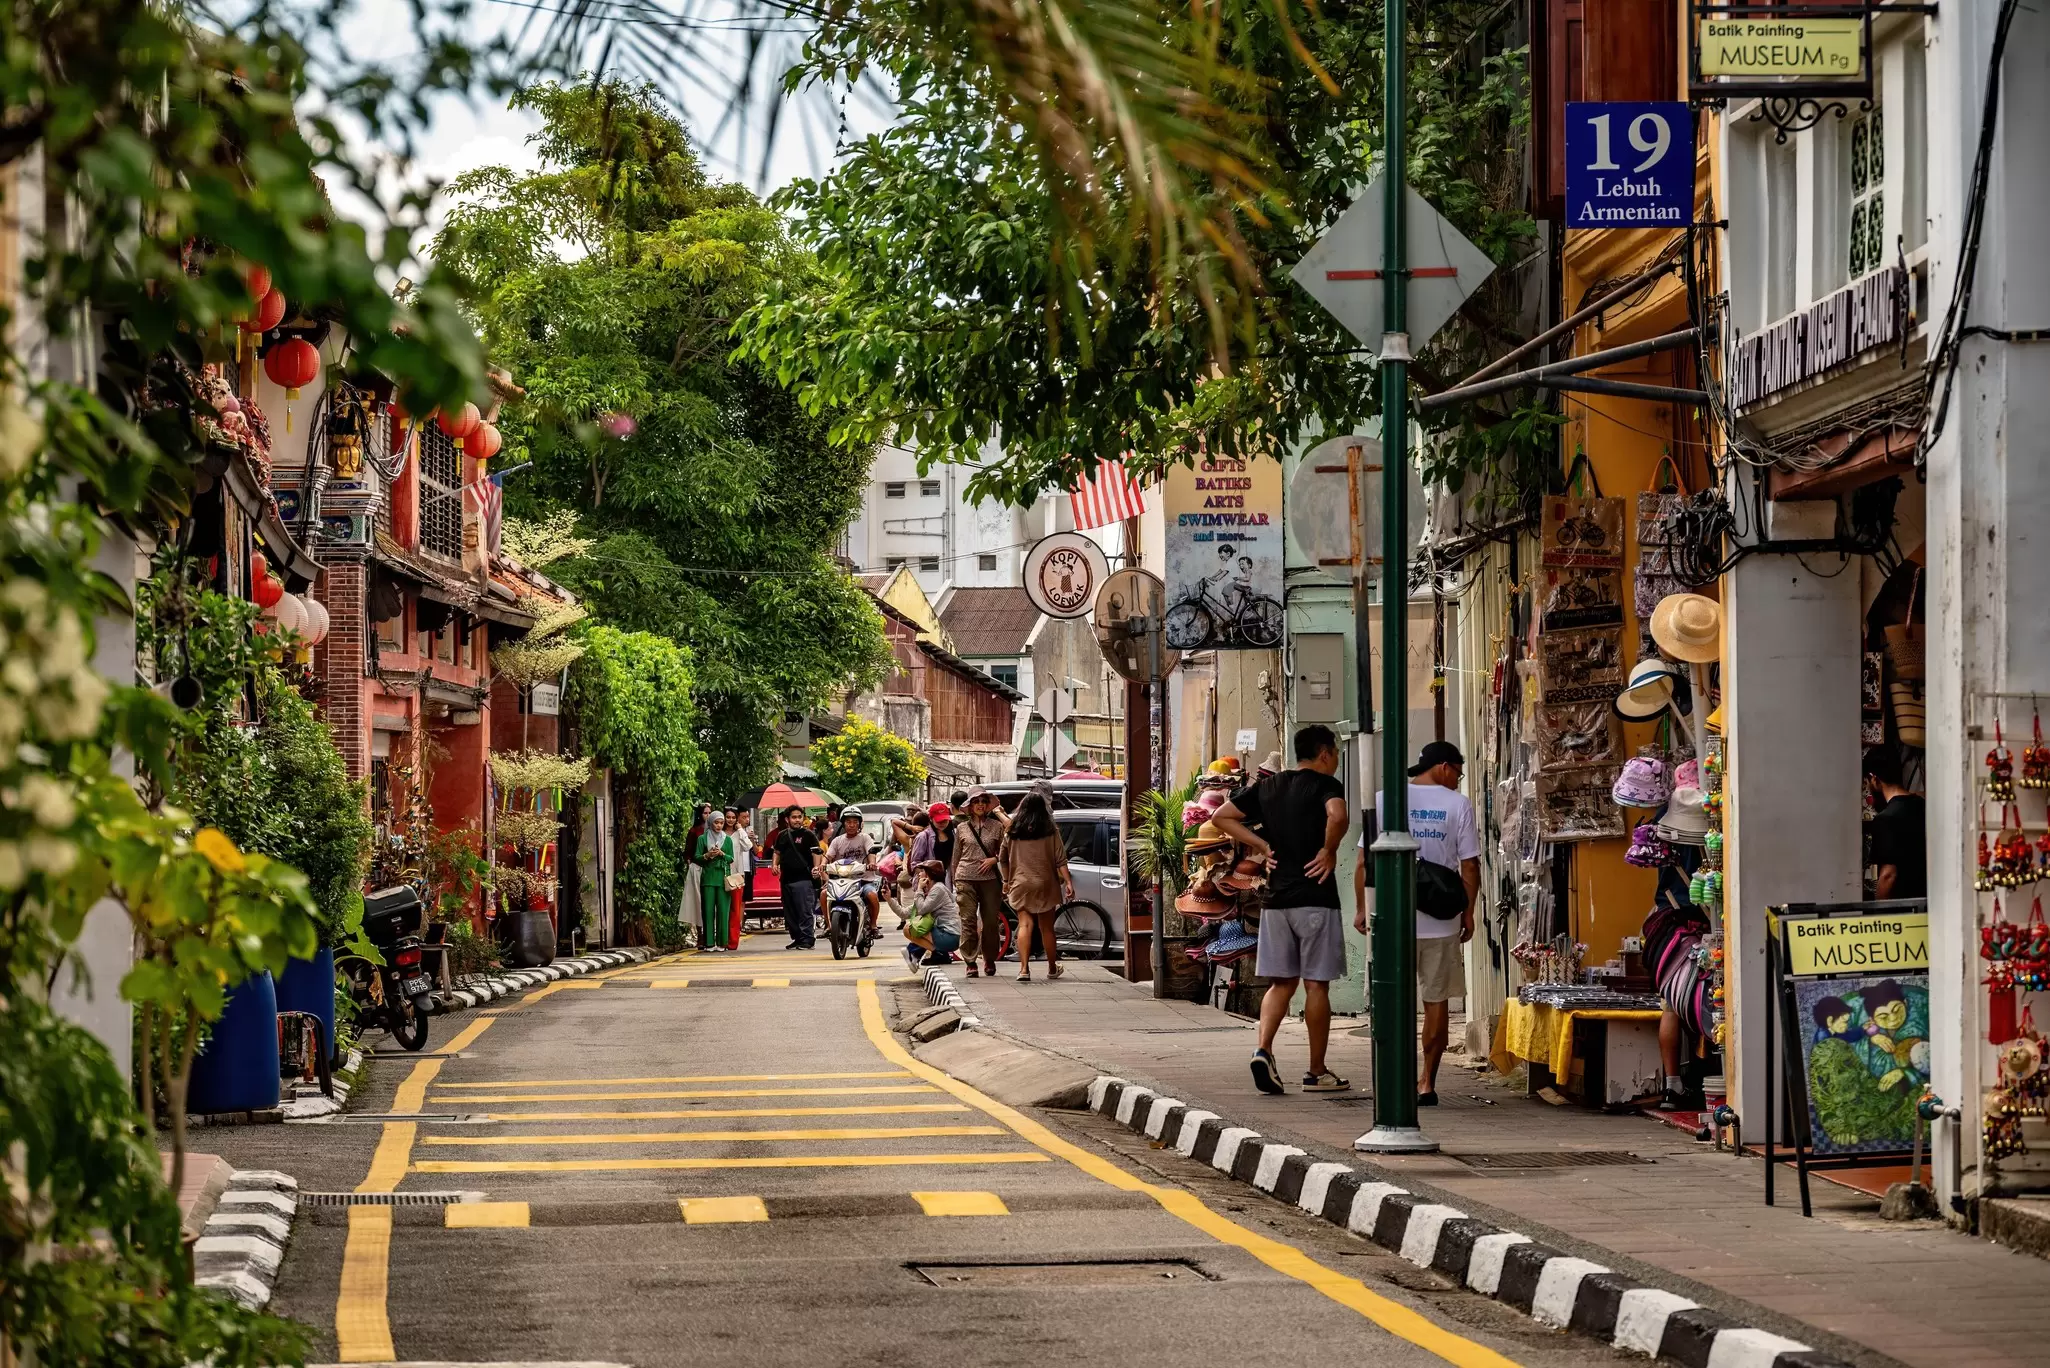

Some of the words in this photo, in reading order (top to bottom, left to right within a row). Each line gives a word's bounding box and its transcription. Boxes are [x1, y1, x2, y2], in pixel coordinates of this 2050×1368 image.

[1708, 24, 1743, 37] Batik
[1747, 24, 1804, 39] Painting
[1720, 45, 1824, 66] MUSEUM
[1830, 53, 1849, 69] Pg
[1586, 113, 1671, 173] 19
[1596, 177, 1662, 197] Lebuh
[1578, 201, 1681, 221] Armenian
[1732, 336, 1758, 410] BATIK
[1805, 290, 1850, 374] MUSEUM
[1850, 267, 1896, 357] PENANG
[1200, 459, 1246, 472] GIFTS
[1195, 477, 1252, 490] BATIKS
[1203, 495, 1244, 508] ARTS
[1178, 512, 1270, 527] SWIMWEAR
[1193, 530, 1214, 542] and
[1049, 583, 1084, 606] LOEWAK
[1412, 828, 1447, 841] holiday
[1797, 923, 1836, 937] Batik
[1840, 920, 1903, 935] Painting
[1814, 940, 1928, 967] MUSEUM
[409, 978, 424, 987] PPE
[411, 983, 428, 992] 9715
